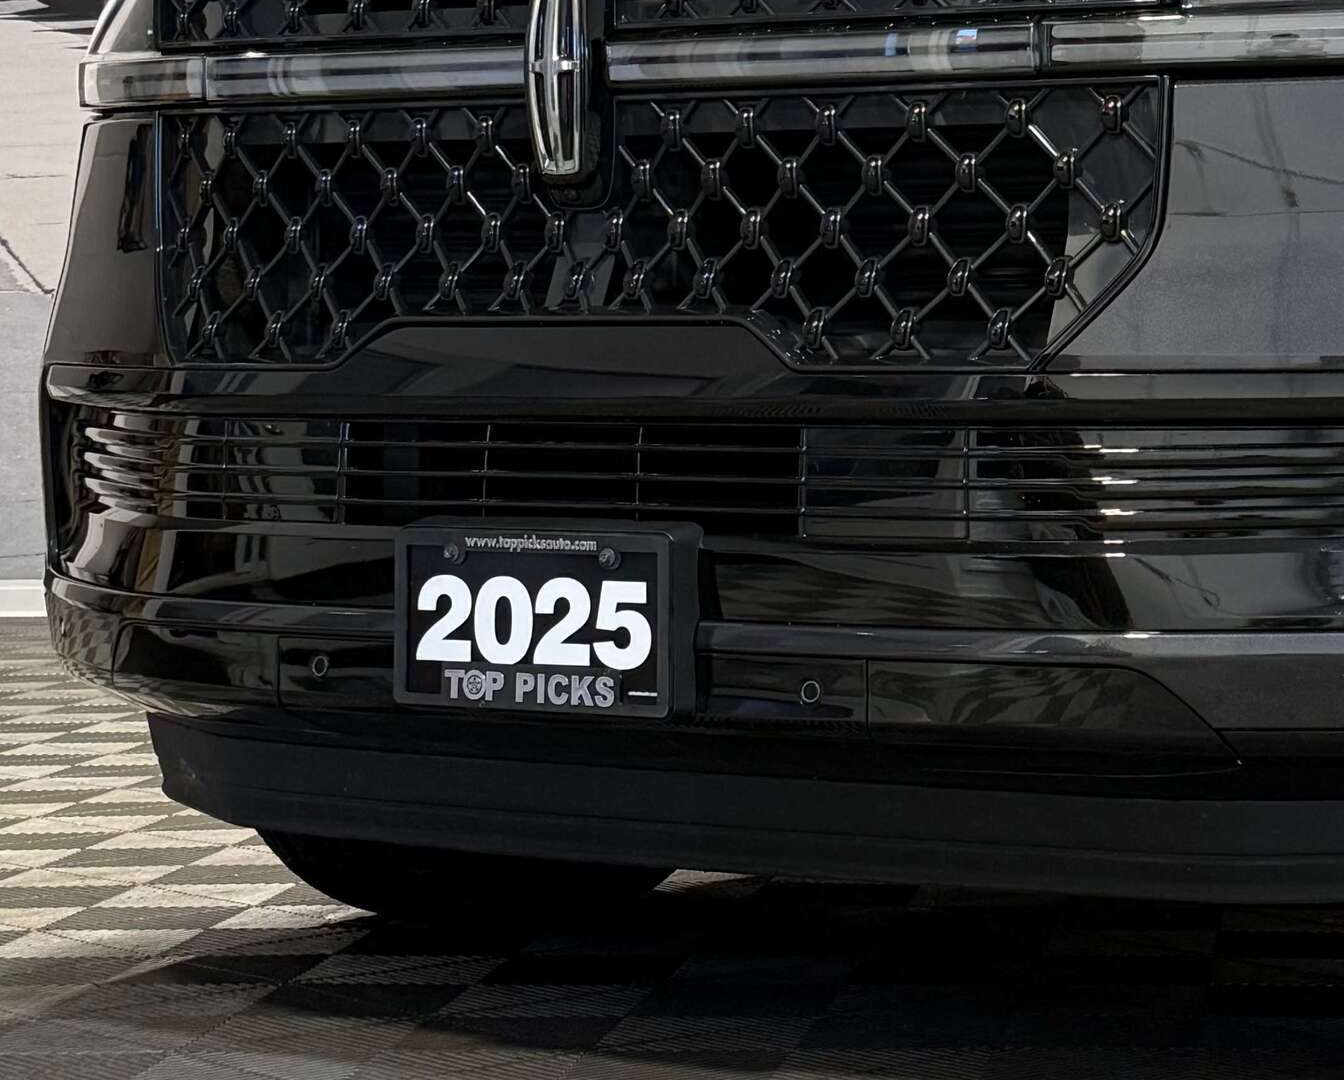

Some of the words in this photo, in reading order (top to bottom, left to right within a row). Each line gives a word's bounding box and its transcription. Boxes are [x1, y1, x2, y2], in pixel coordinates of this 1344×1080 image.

[465, 534, 597, 553] www.toppicksauto.com
[415, 574, 652, 670] 2025
[444, 669, 504, 701] TOP
[515, 672, 615, 707] PICKS
